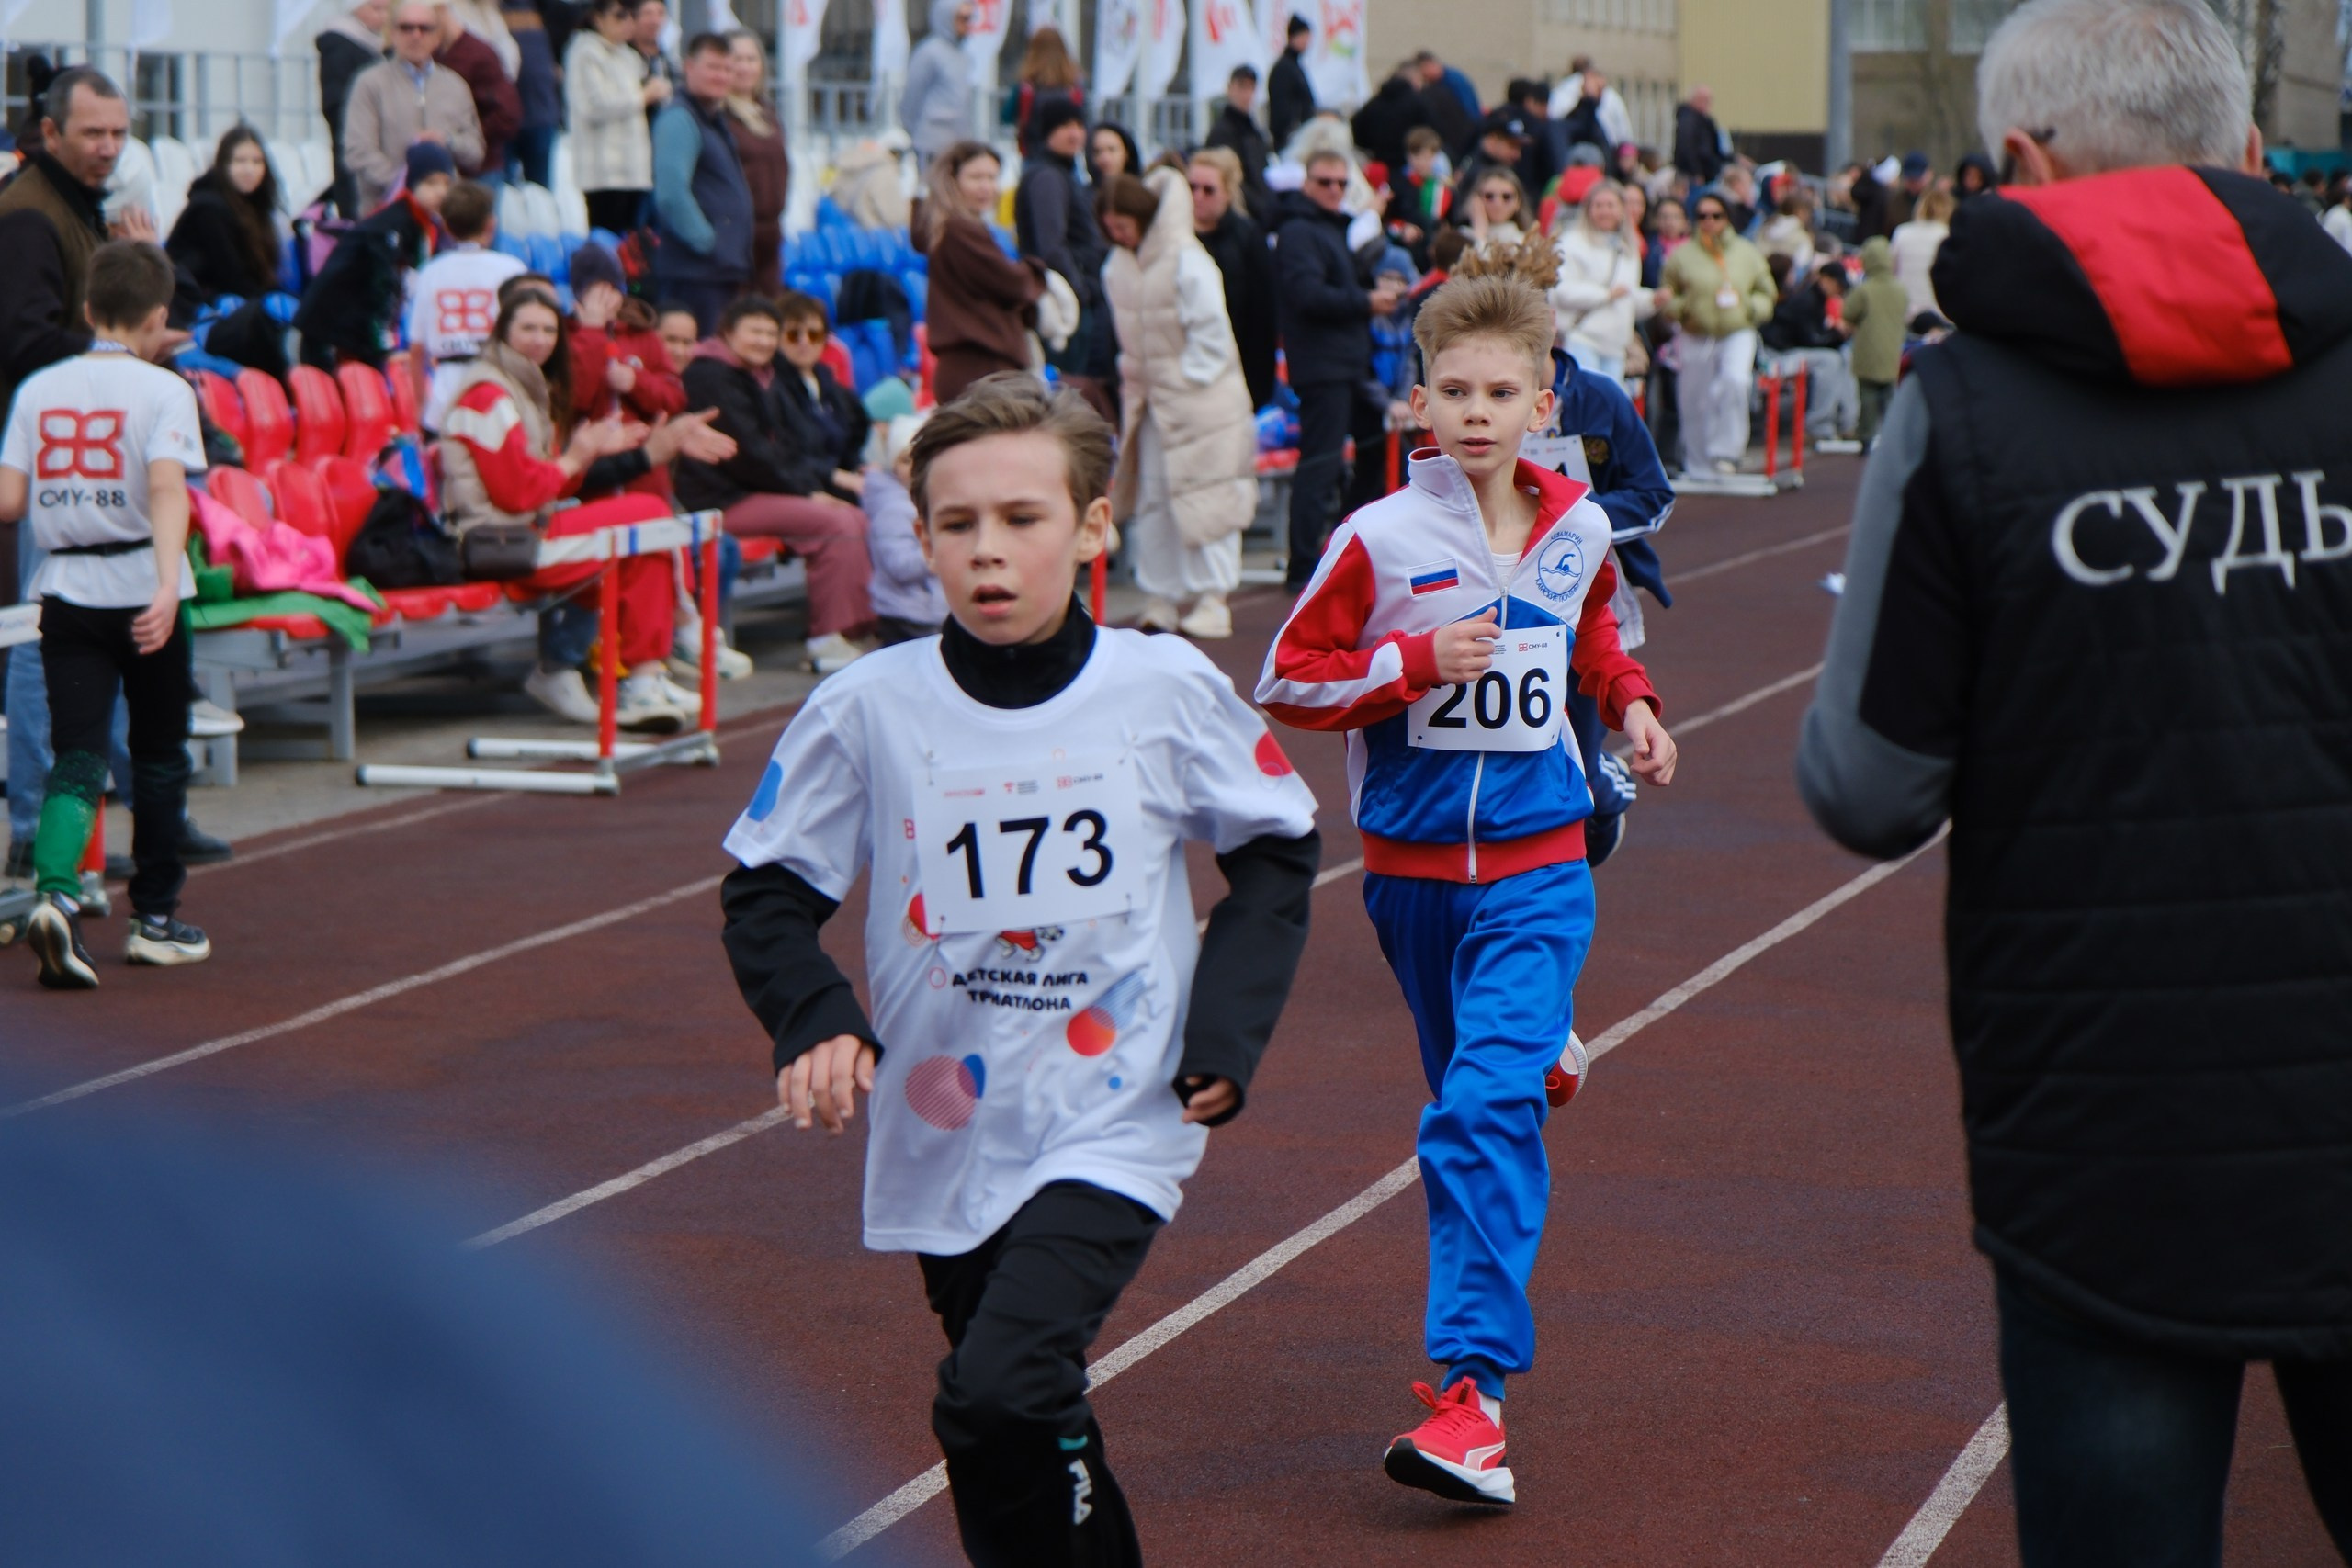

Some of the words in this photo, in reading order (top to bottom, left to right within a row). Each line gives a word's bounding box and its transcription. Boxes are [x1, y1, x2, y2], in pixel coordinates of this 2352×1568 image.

[2051, 469, 2352, 596] СУДЬ
[1428, 668, 1552, 729] 206
[946, 808, 1114, 899] 173
[953, 968, 1037, 987] ДЕТСКАЯ
[1042, 971, 1089, 987] ЛИГА
[967, 989, 1072, 1011] ТРИАТЛОНА
[1068, 1458, 1092, 1526] FILA
